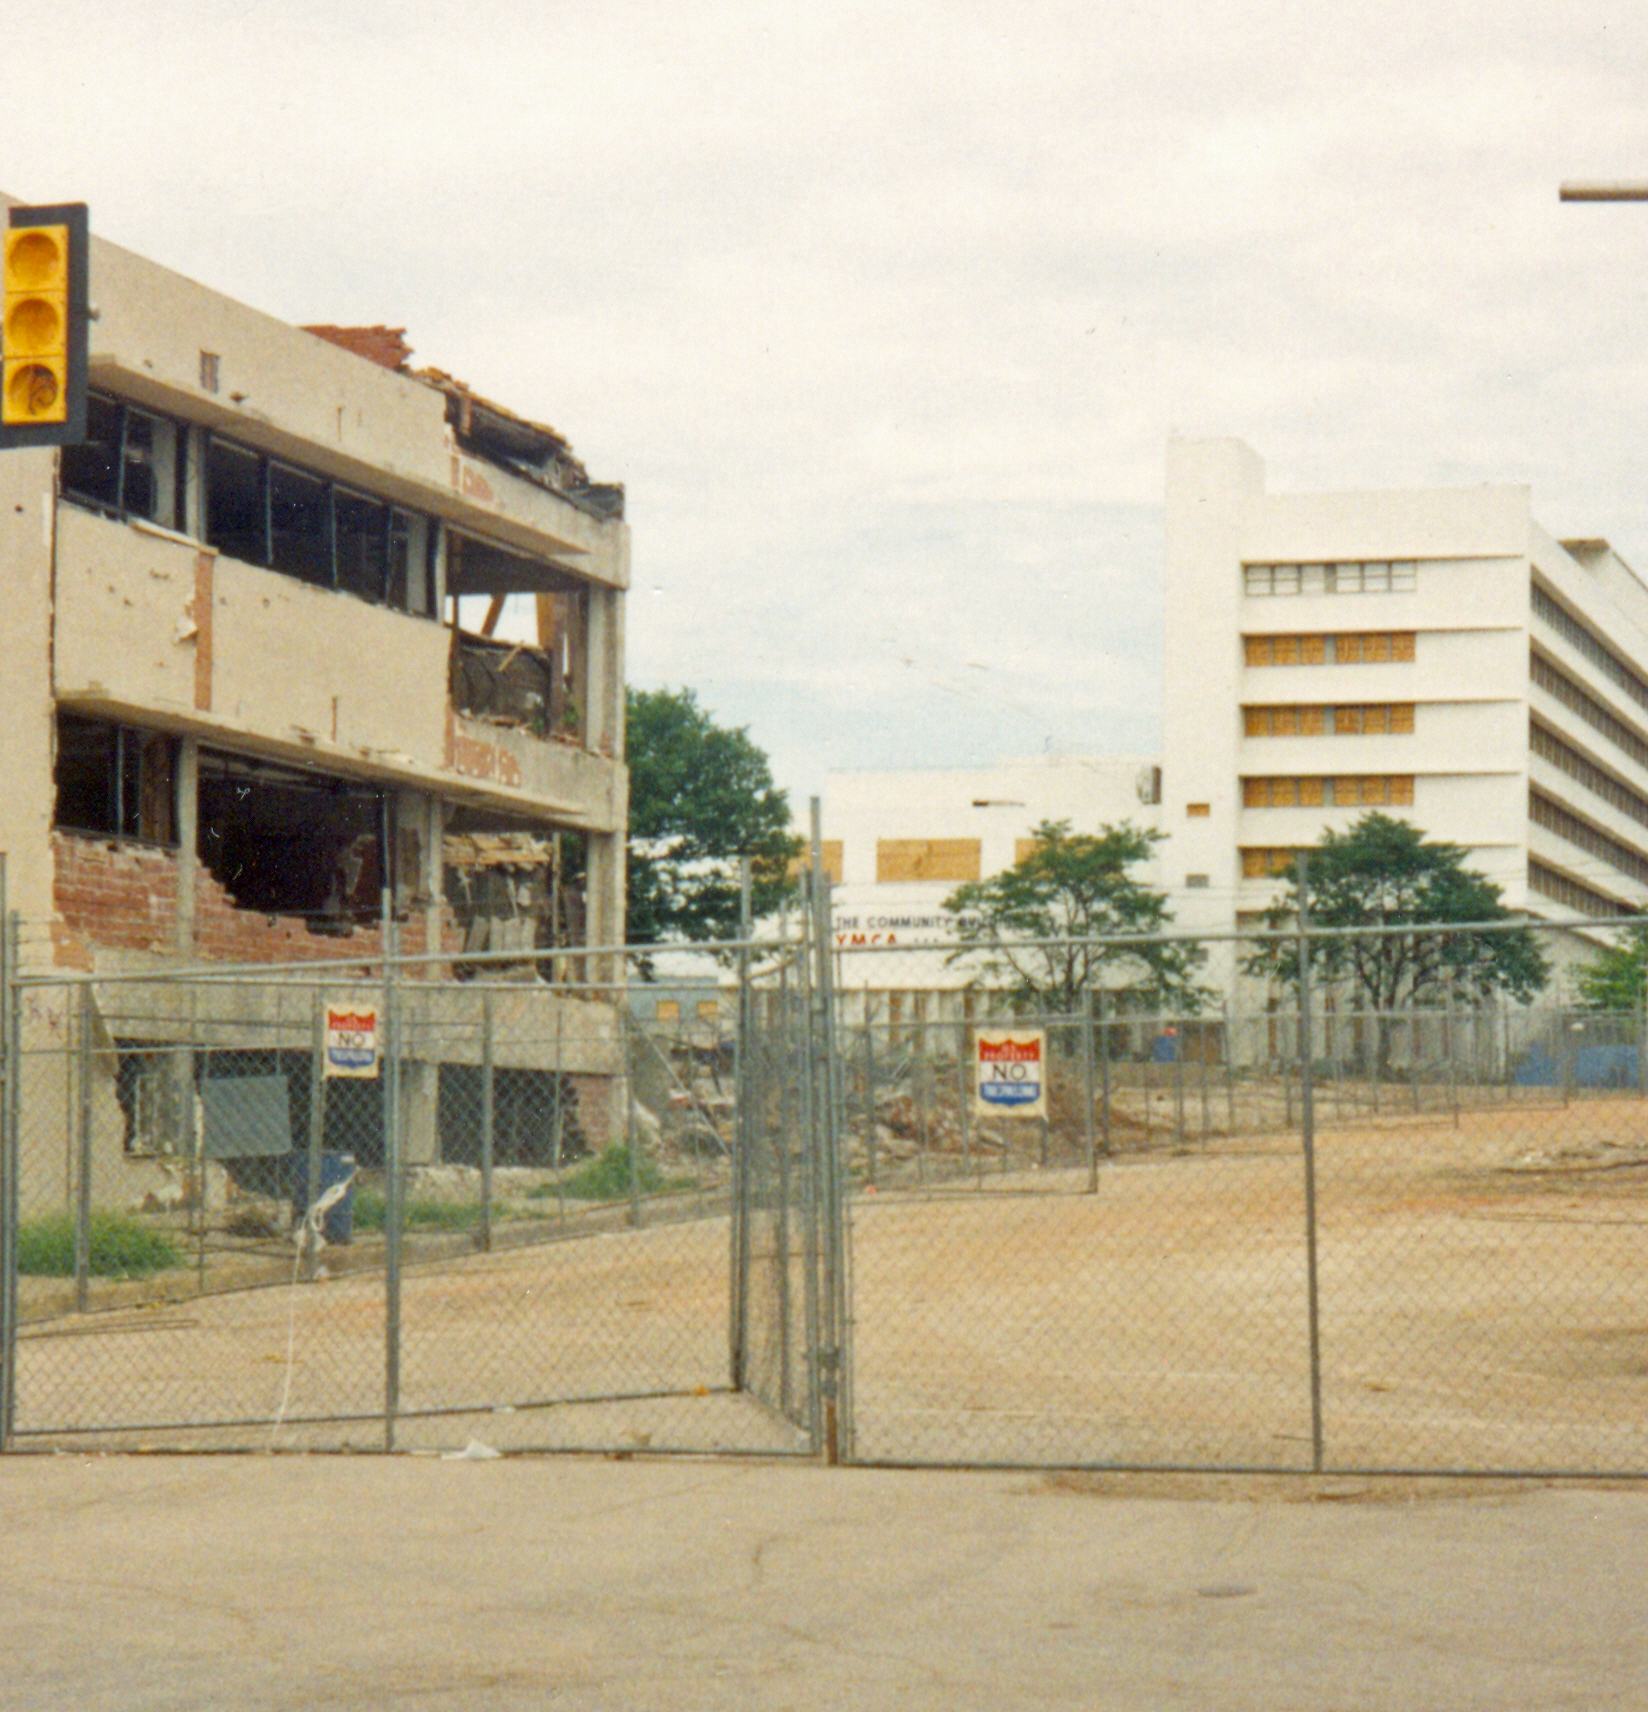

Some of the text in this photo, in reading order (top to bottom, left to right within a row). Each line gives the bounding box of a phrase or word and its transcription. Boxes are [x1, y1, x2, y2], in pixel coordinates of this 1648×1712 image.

[836, 915, 859, 928] THE
[867, 915, 951, 928] COMMUNITY
[835, 933, 897, 946] YMCA
[338, 1032, 365, 1048] NO
[992, 1063, 1027, 1081] NO
